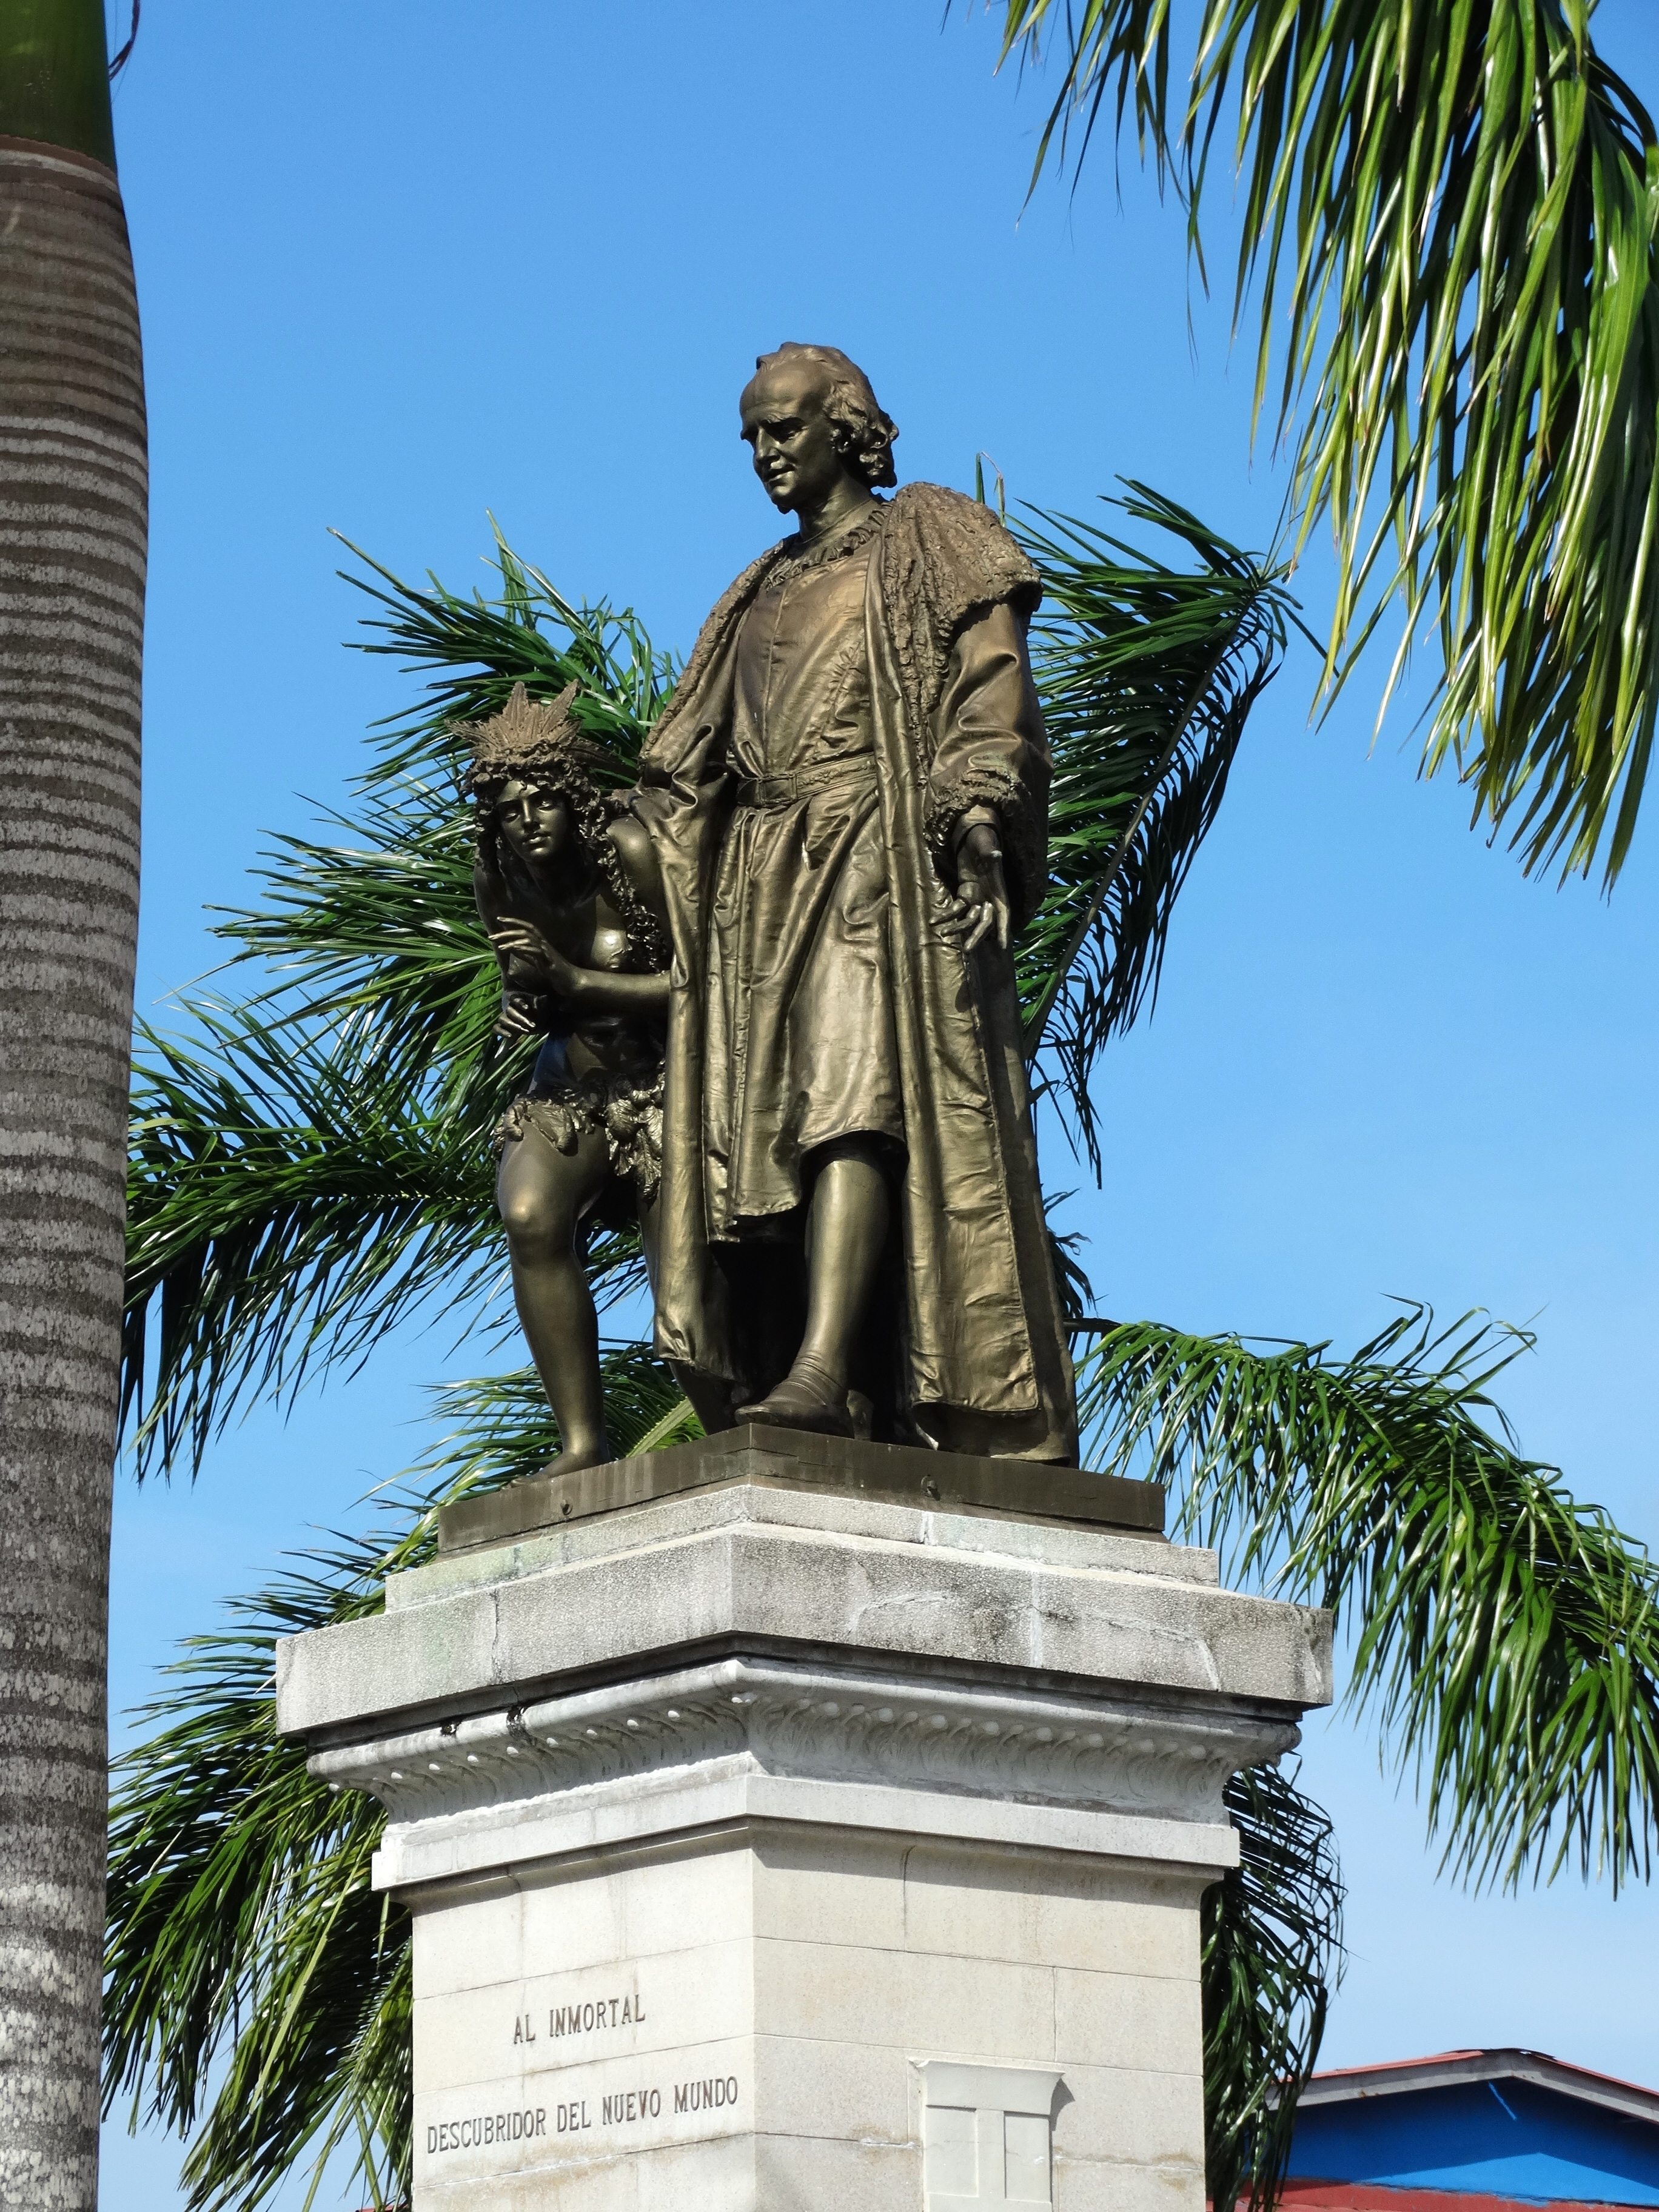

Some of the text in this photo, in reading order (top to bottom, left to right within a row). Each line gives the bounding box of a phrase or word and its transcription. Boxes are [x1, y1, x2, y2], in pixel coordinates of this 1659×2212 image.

[513, 1994, 646, 2045] AL INMORTAL
[427, 2076, 738, 2153] DESCUBRIDOR DEL NUEVO MUNDO
